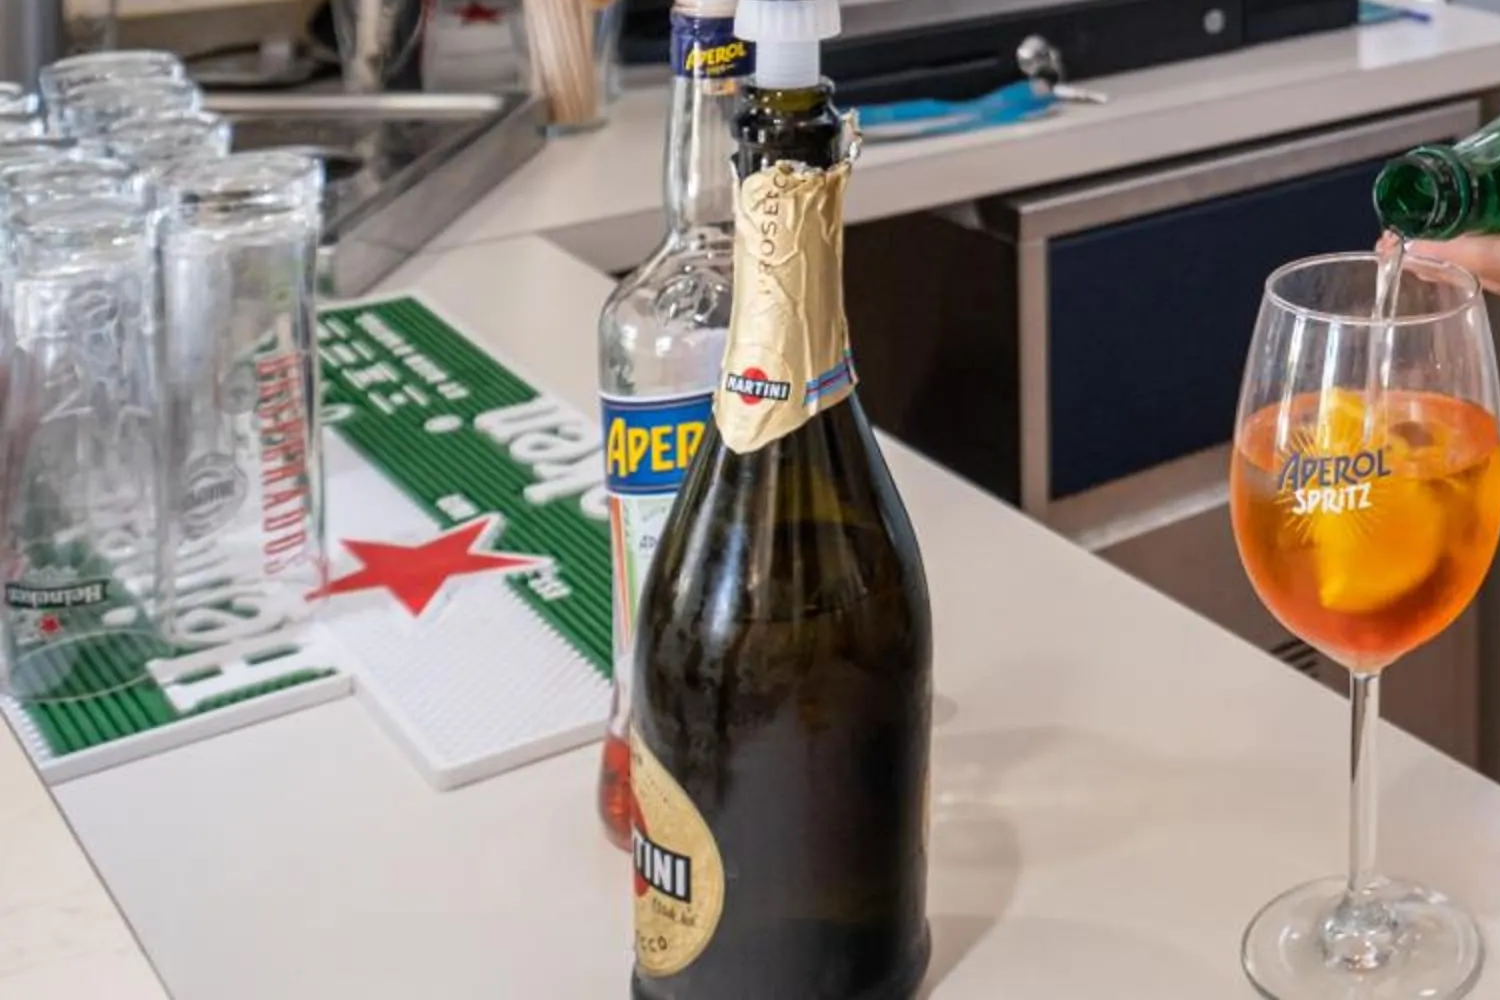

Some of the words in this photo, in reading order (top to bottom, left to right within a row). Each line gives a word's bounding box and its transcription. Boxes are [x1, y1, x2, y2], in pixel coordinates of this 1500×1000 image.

[684, 41, 747, 71] APEROL
[726, 373, 789, 401] MARTINI
[607, 417, 706, 478] APER
[1278, 447, 1392, 490] APEROL
[1292, 481, 1373, 515] SPRITZ
[633, 830, 688, 898] TINI
